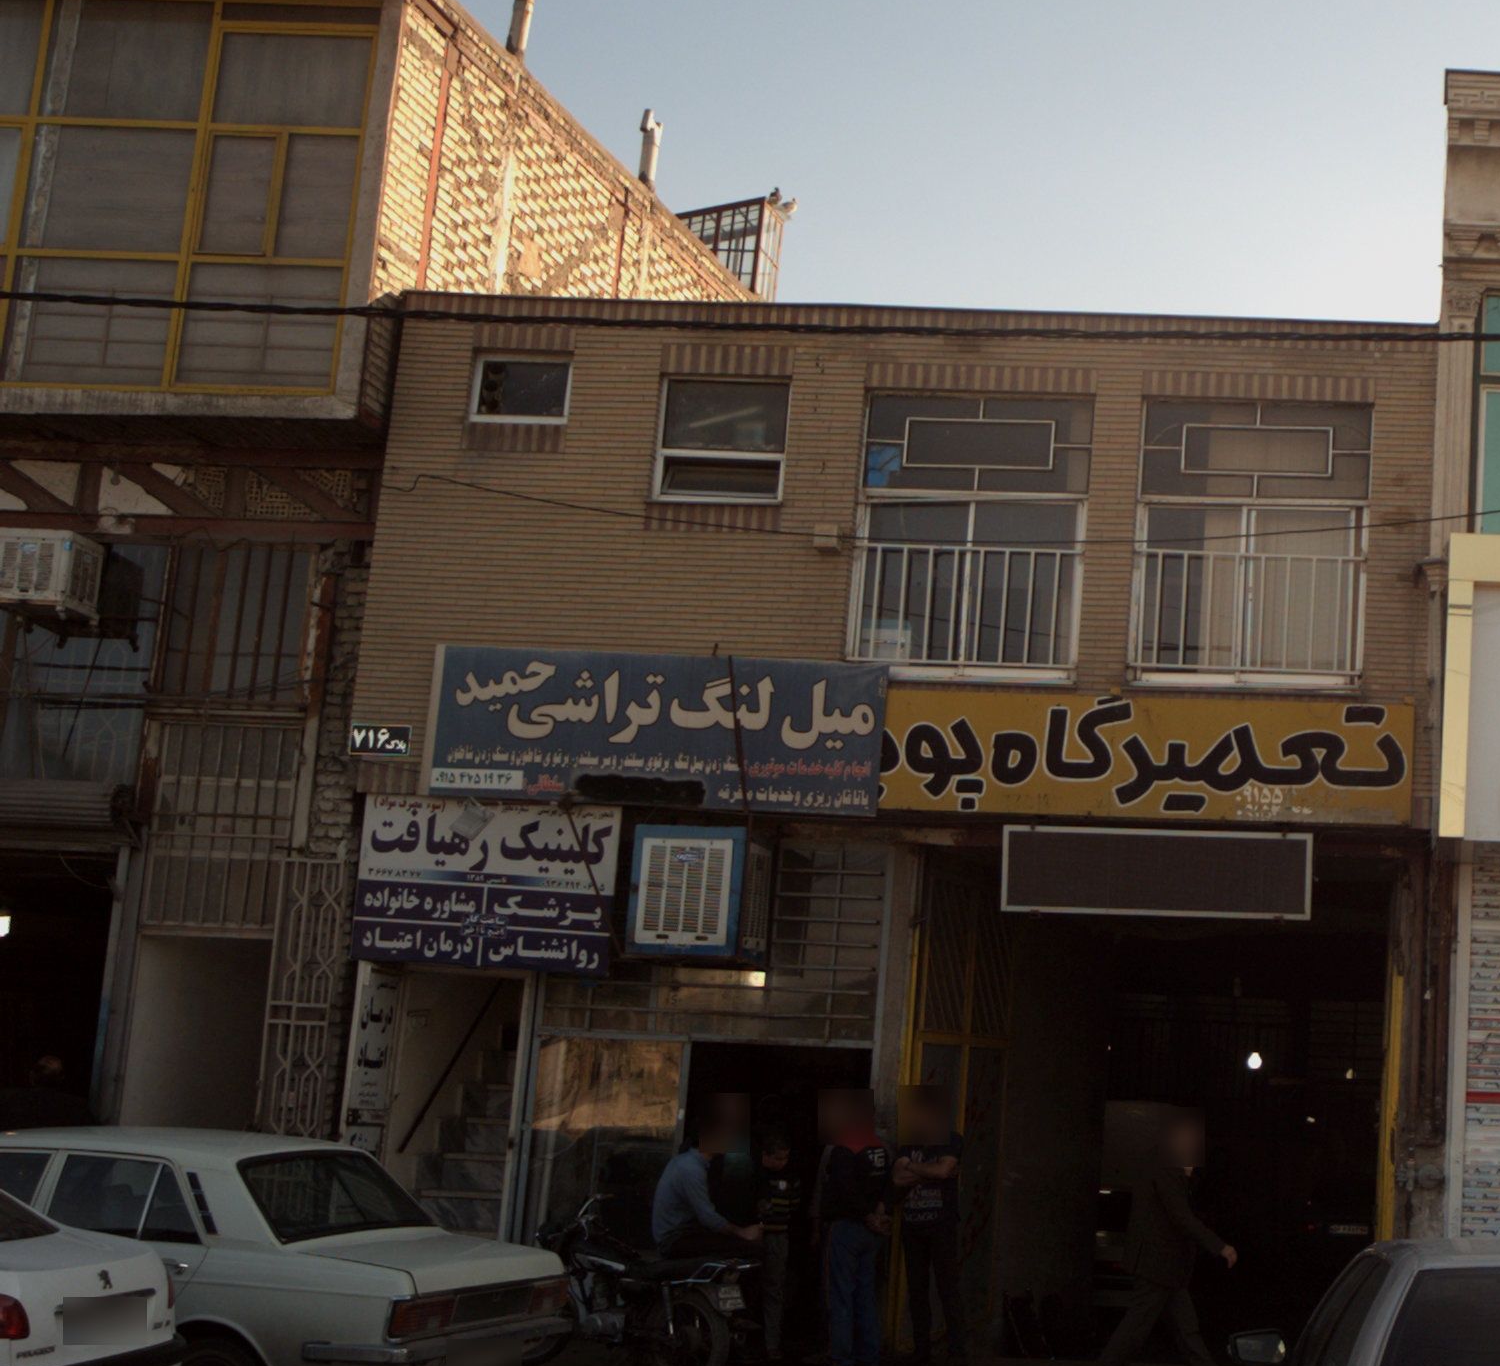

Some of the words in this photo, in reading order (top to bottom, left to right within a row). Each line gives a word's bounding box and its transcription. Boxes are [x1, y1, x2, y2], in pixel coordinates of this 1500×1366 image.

[455, 659, 556, 714] حمید
[669, 674, 775, 730] لنگ
[507, 667, 665, 744] تراشی
[780, 678, 876, 751] میل
[353, 727, 391, 749] ۷۱۶
[384, 738, 407, 754] پلاک
[991, 695, 1407, 813] تعمیرگاه
[786, 758, 823, 779] خدمات
[718, 783, 754, 804] مفرقه
[371, 809, 489, 872] رهیافت
[500, 819, 613, 875] کلینیک
[363, 887, 421, 916] خانواده
[423, 890, 477, 919] مشاوره
[493, 895, 602, 929] پزشک
[361, 926, 422, 955] اعتیاد
[423, 930, 474, 960] درمان
[487, 936, 600, 970] روانشناس
